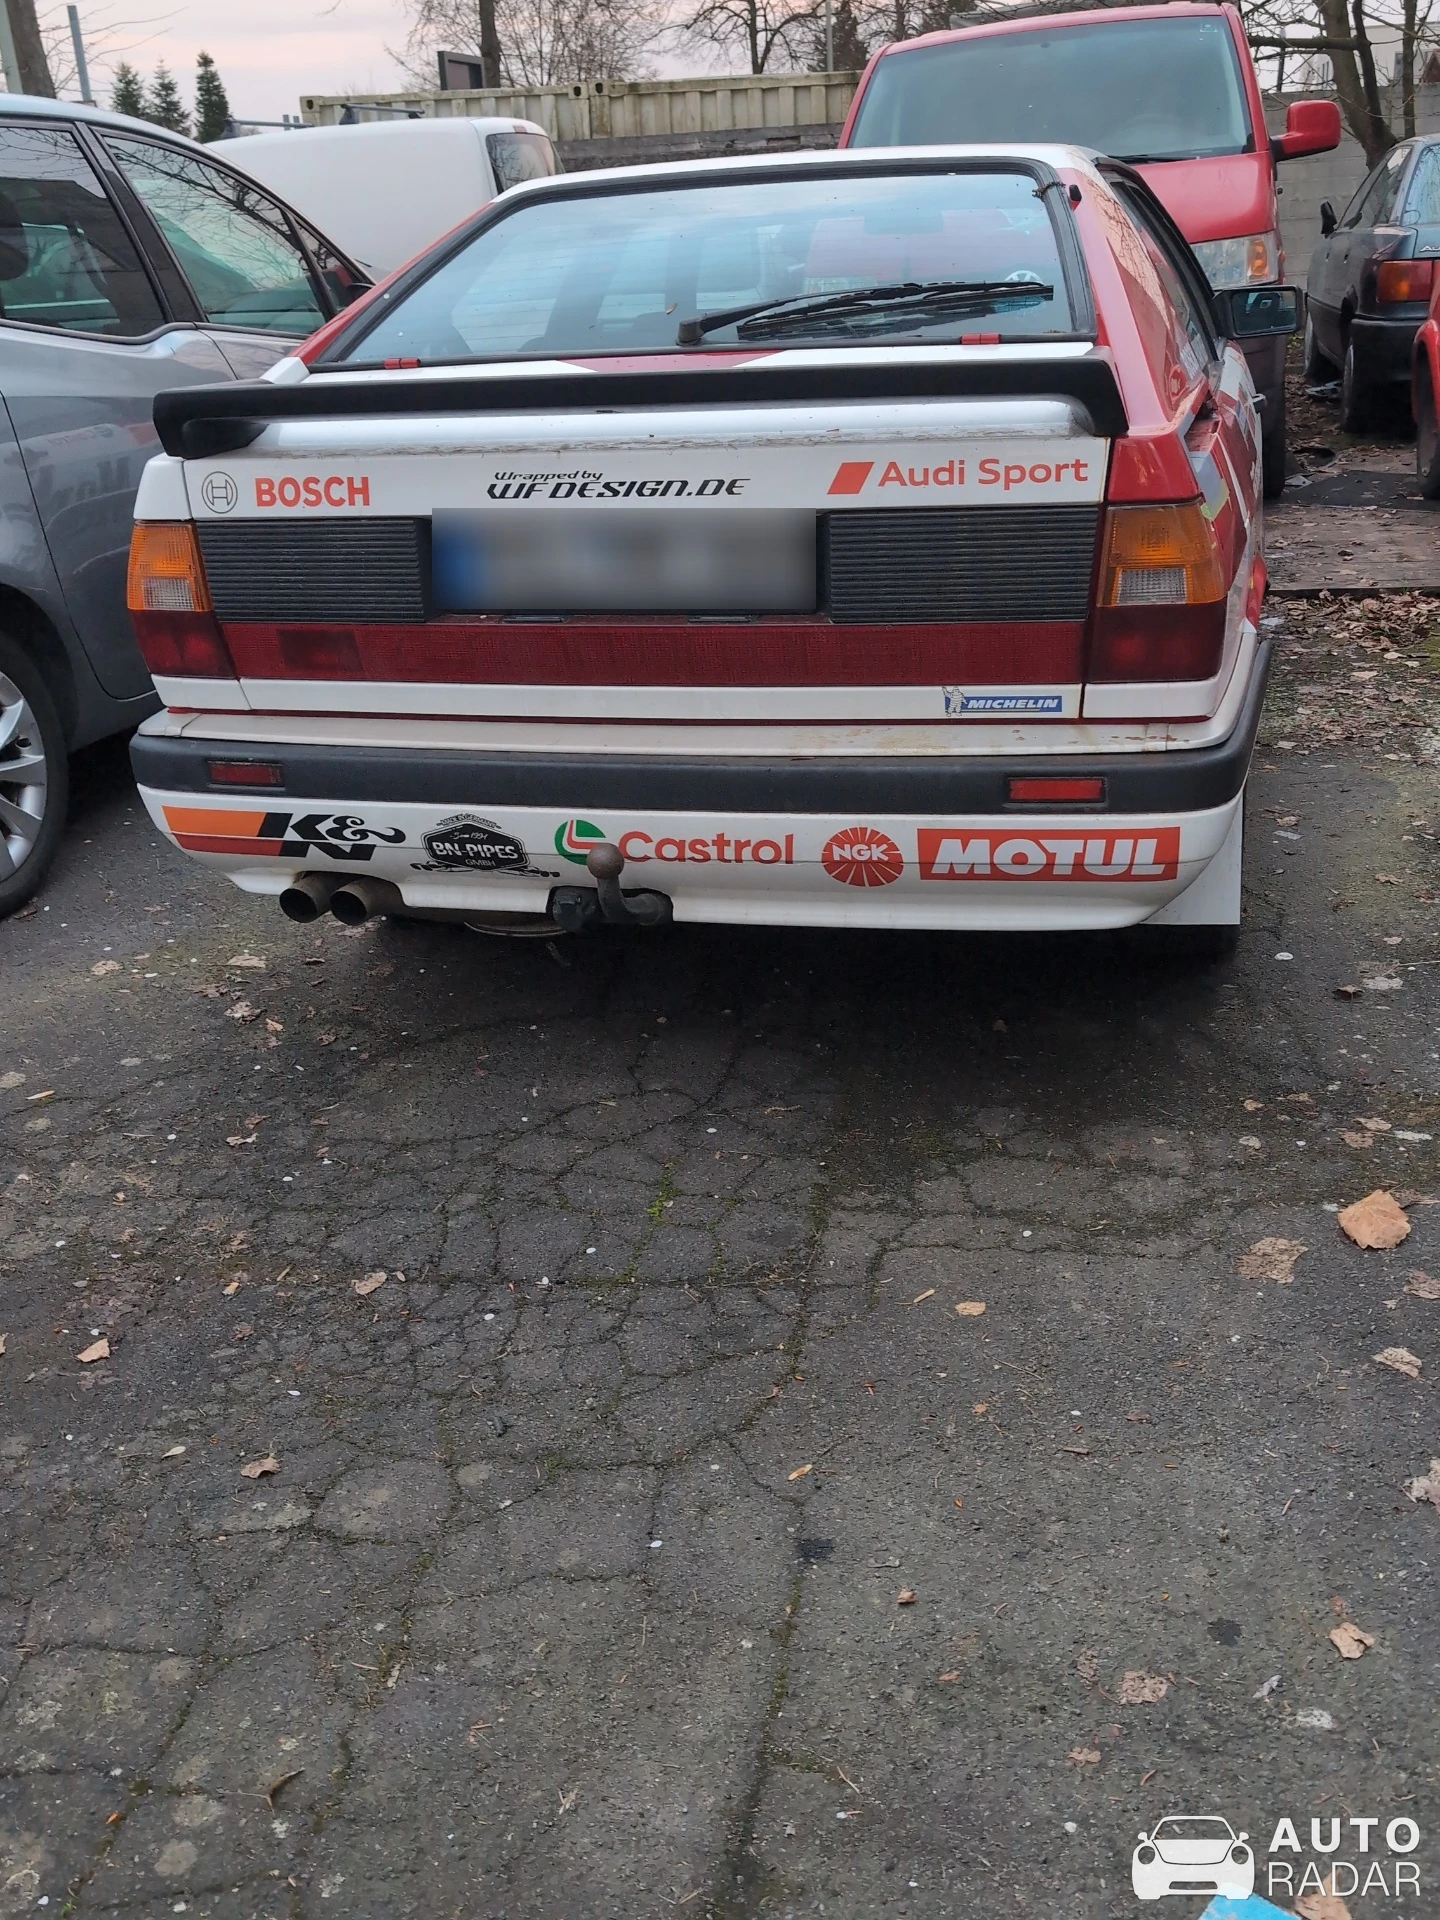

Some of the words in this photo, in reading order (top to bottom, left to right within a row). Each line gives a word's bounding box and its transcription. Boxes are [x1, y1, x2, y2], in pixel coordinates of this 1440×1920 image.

[494, 471, 580, 482] Wrapped
[581, 470, 603, 482] by
[878, 460, 965, 487] Audi
[978, 458, 1088, 490] Sport
[255, 476, 370, 507] BOSCH
[967, 698, 1059, 709] MICHELIN
[432, 841, 518, 859] BN-PIPES
[618, 831, 794, 865] Castrol
[832, 843, 889, 862] NGK
[931, 838, 1167, 876] MOTUL
